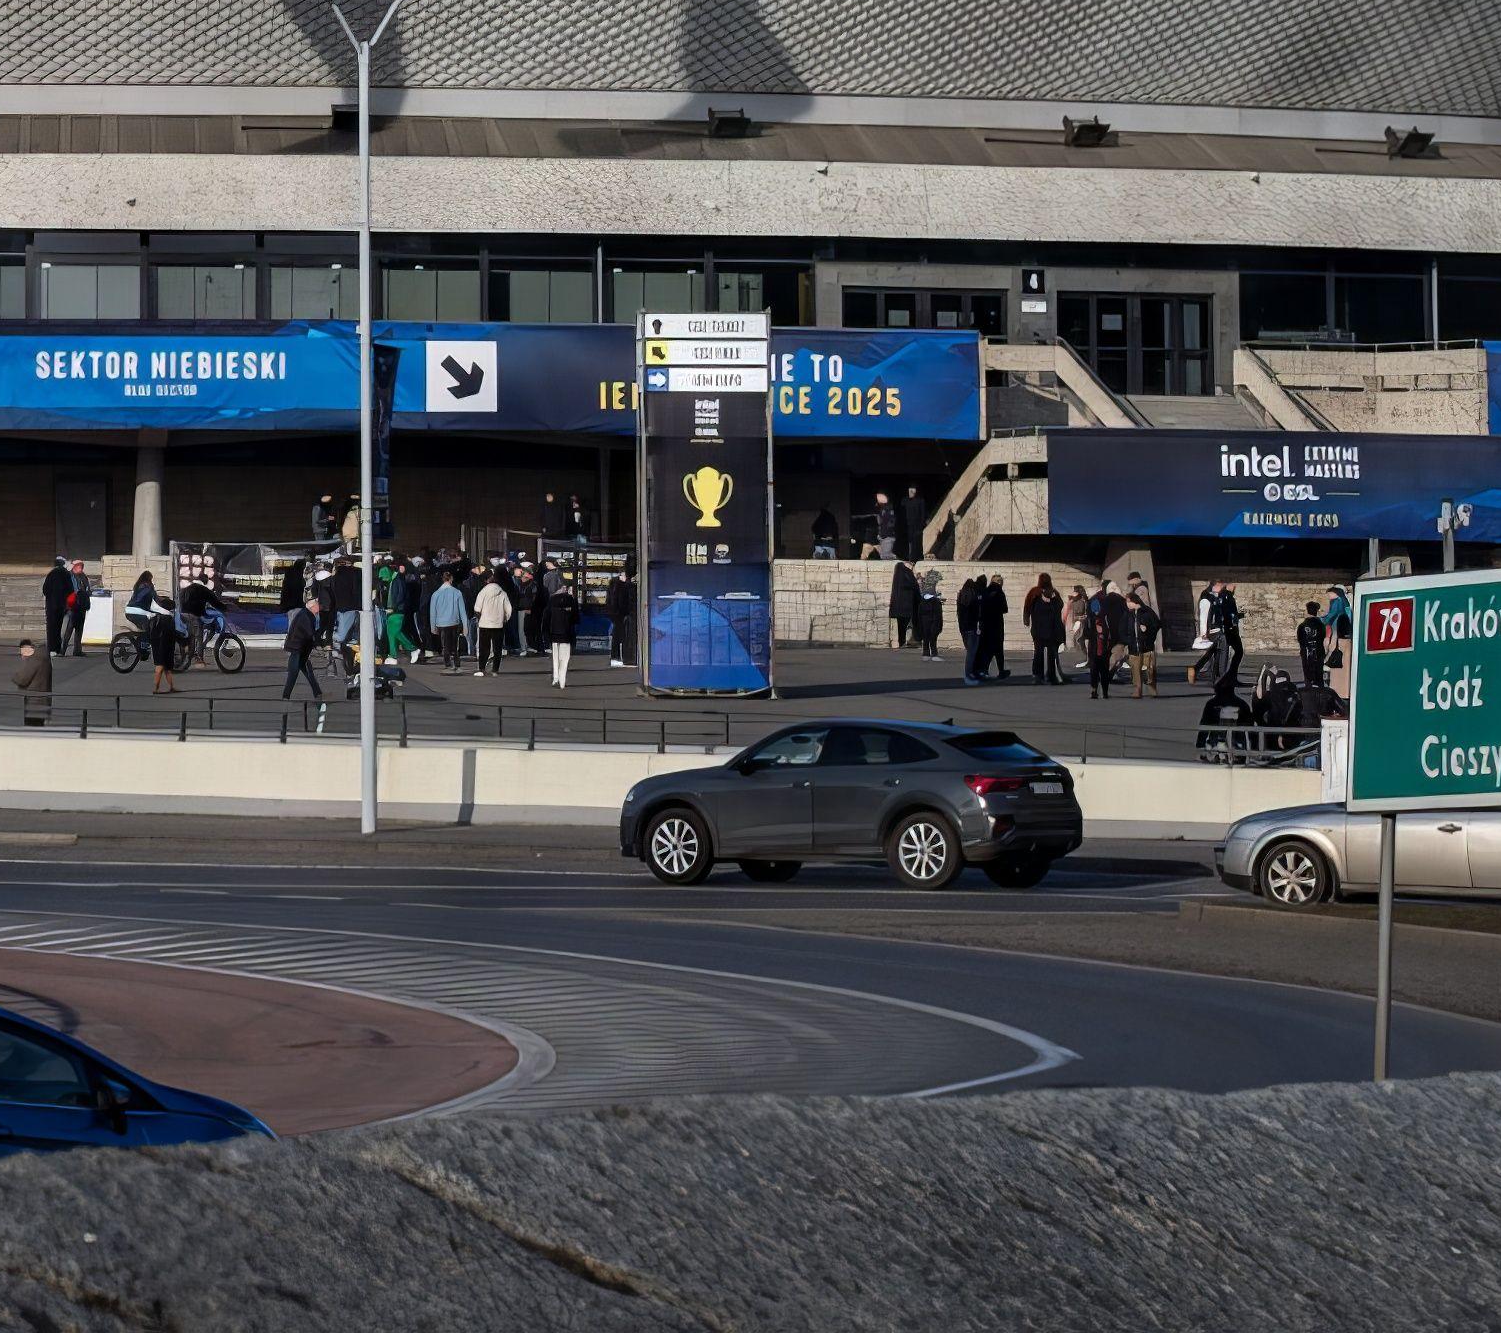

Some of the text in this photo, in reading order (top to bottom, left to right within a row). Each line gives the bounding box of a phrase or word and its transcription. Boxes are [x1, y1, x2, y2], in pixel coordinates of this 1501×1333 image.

[35, 351, 287, 380] SEKTOR NIEBIESKI
[810, 354, 844, 382] TO
[827, 386, 902, 417] 2025
[1379, 607, 1402, 643] 79
[1419, 665, 1484, 711] Łódź
